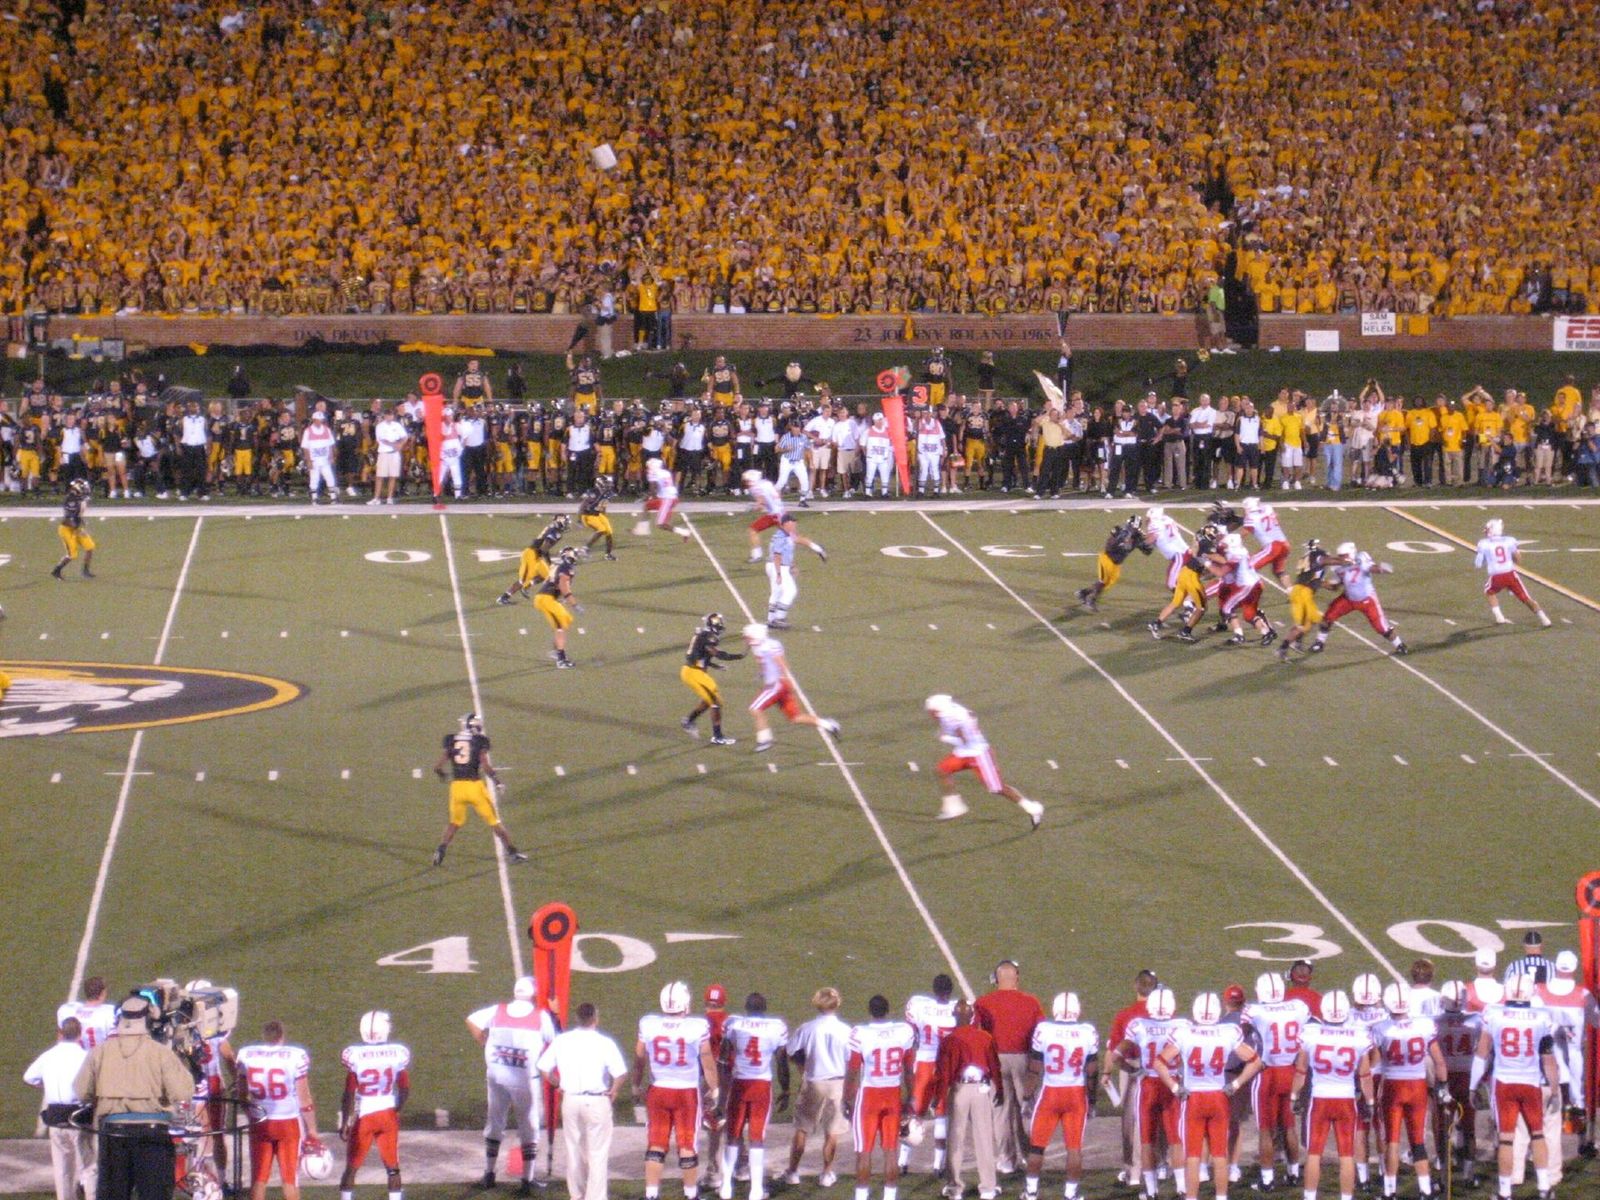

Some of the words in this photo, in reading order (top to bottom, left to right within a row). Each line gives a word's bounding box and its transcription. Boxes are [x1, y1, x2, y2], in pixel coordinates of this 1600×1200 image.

[951, 328, 1013, 341] ROLAND
[1363, 325, 1393, 333] HELEN
[465, 374, 482, 386] 55
[911, 386, 928, 405] 3
[1495, 546, 1506, 564] 9
[453, 740, 471, 765] 3
[653, 1036, 687, 1066] 61
[744, 1036, 762, 1066] 4
[1270, 1021, 1301, 1054] 19
[1386, 1037, 1425, 1066] 48
[1501, 1027, 1534, 1057] 81
[870, 1047, 904, 1077] 18
[1045, 1044, 1084, 1077] 34
[1188, 1046, 1224, 1077] 44
[1314, 1044, 1356, 1077] 53
[247, 1067, 288, 1101] 56
[358, 1067, 393, 1096] 21
